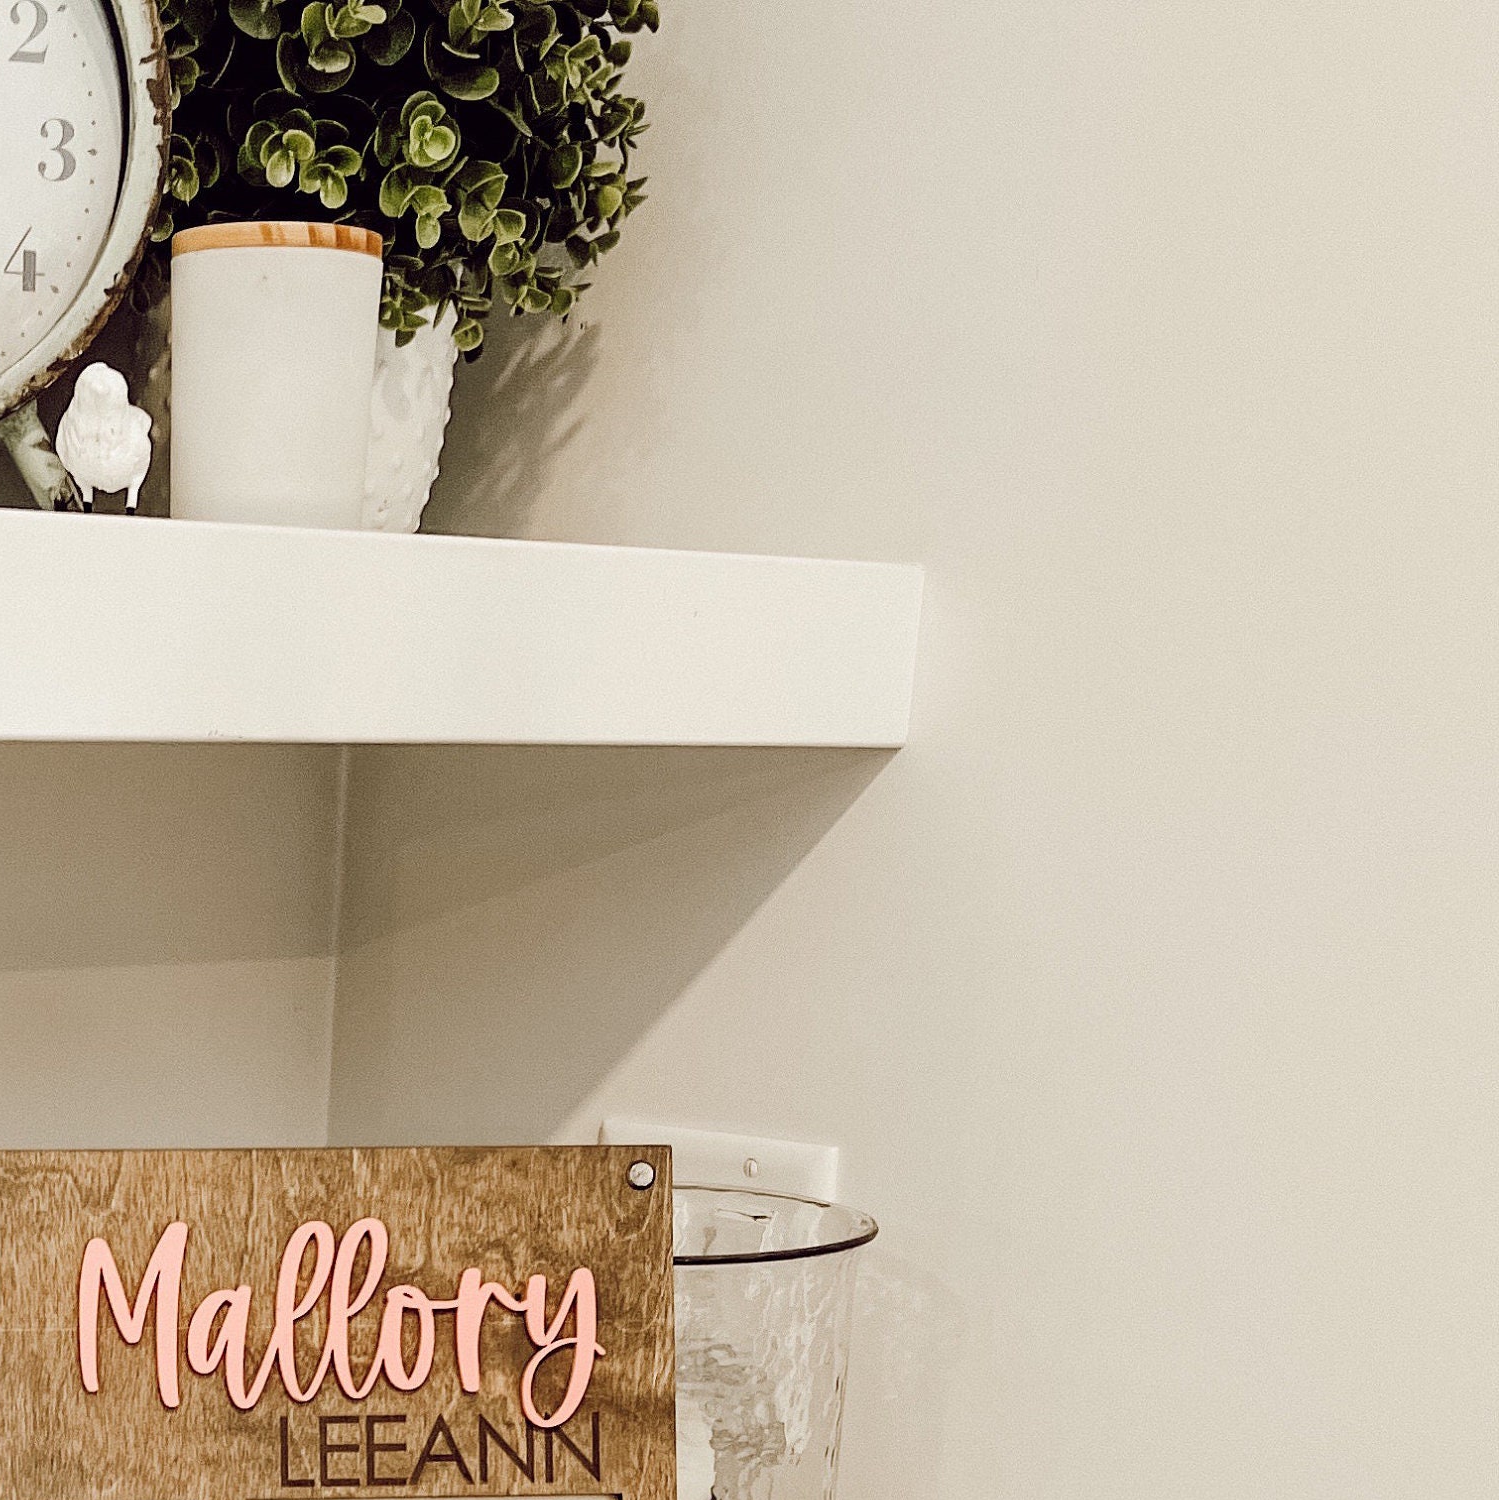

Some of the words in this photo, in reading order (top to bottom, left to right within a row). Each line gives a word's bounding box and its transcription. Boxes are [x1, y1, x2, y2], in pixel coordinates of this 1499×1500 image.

[8, 0, 51, 63] 2
[37, 118, 77, 182] 3
[3, 226, 45, 292] 4
[78, 1217, 607, 1429] Mallory
[280, 1411, 601, 1488] LEEANN
